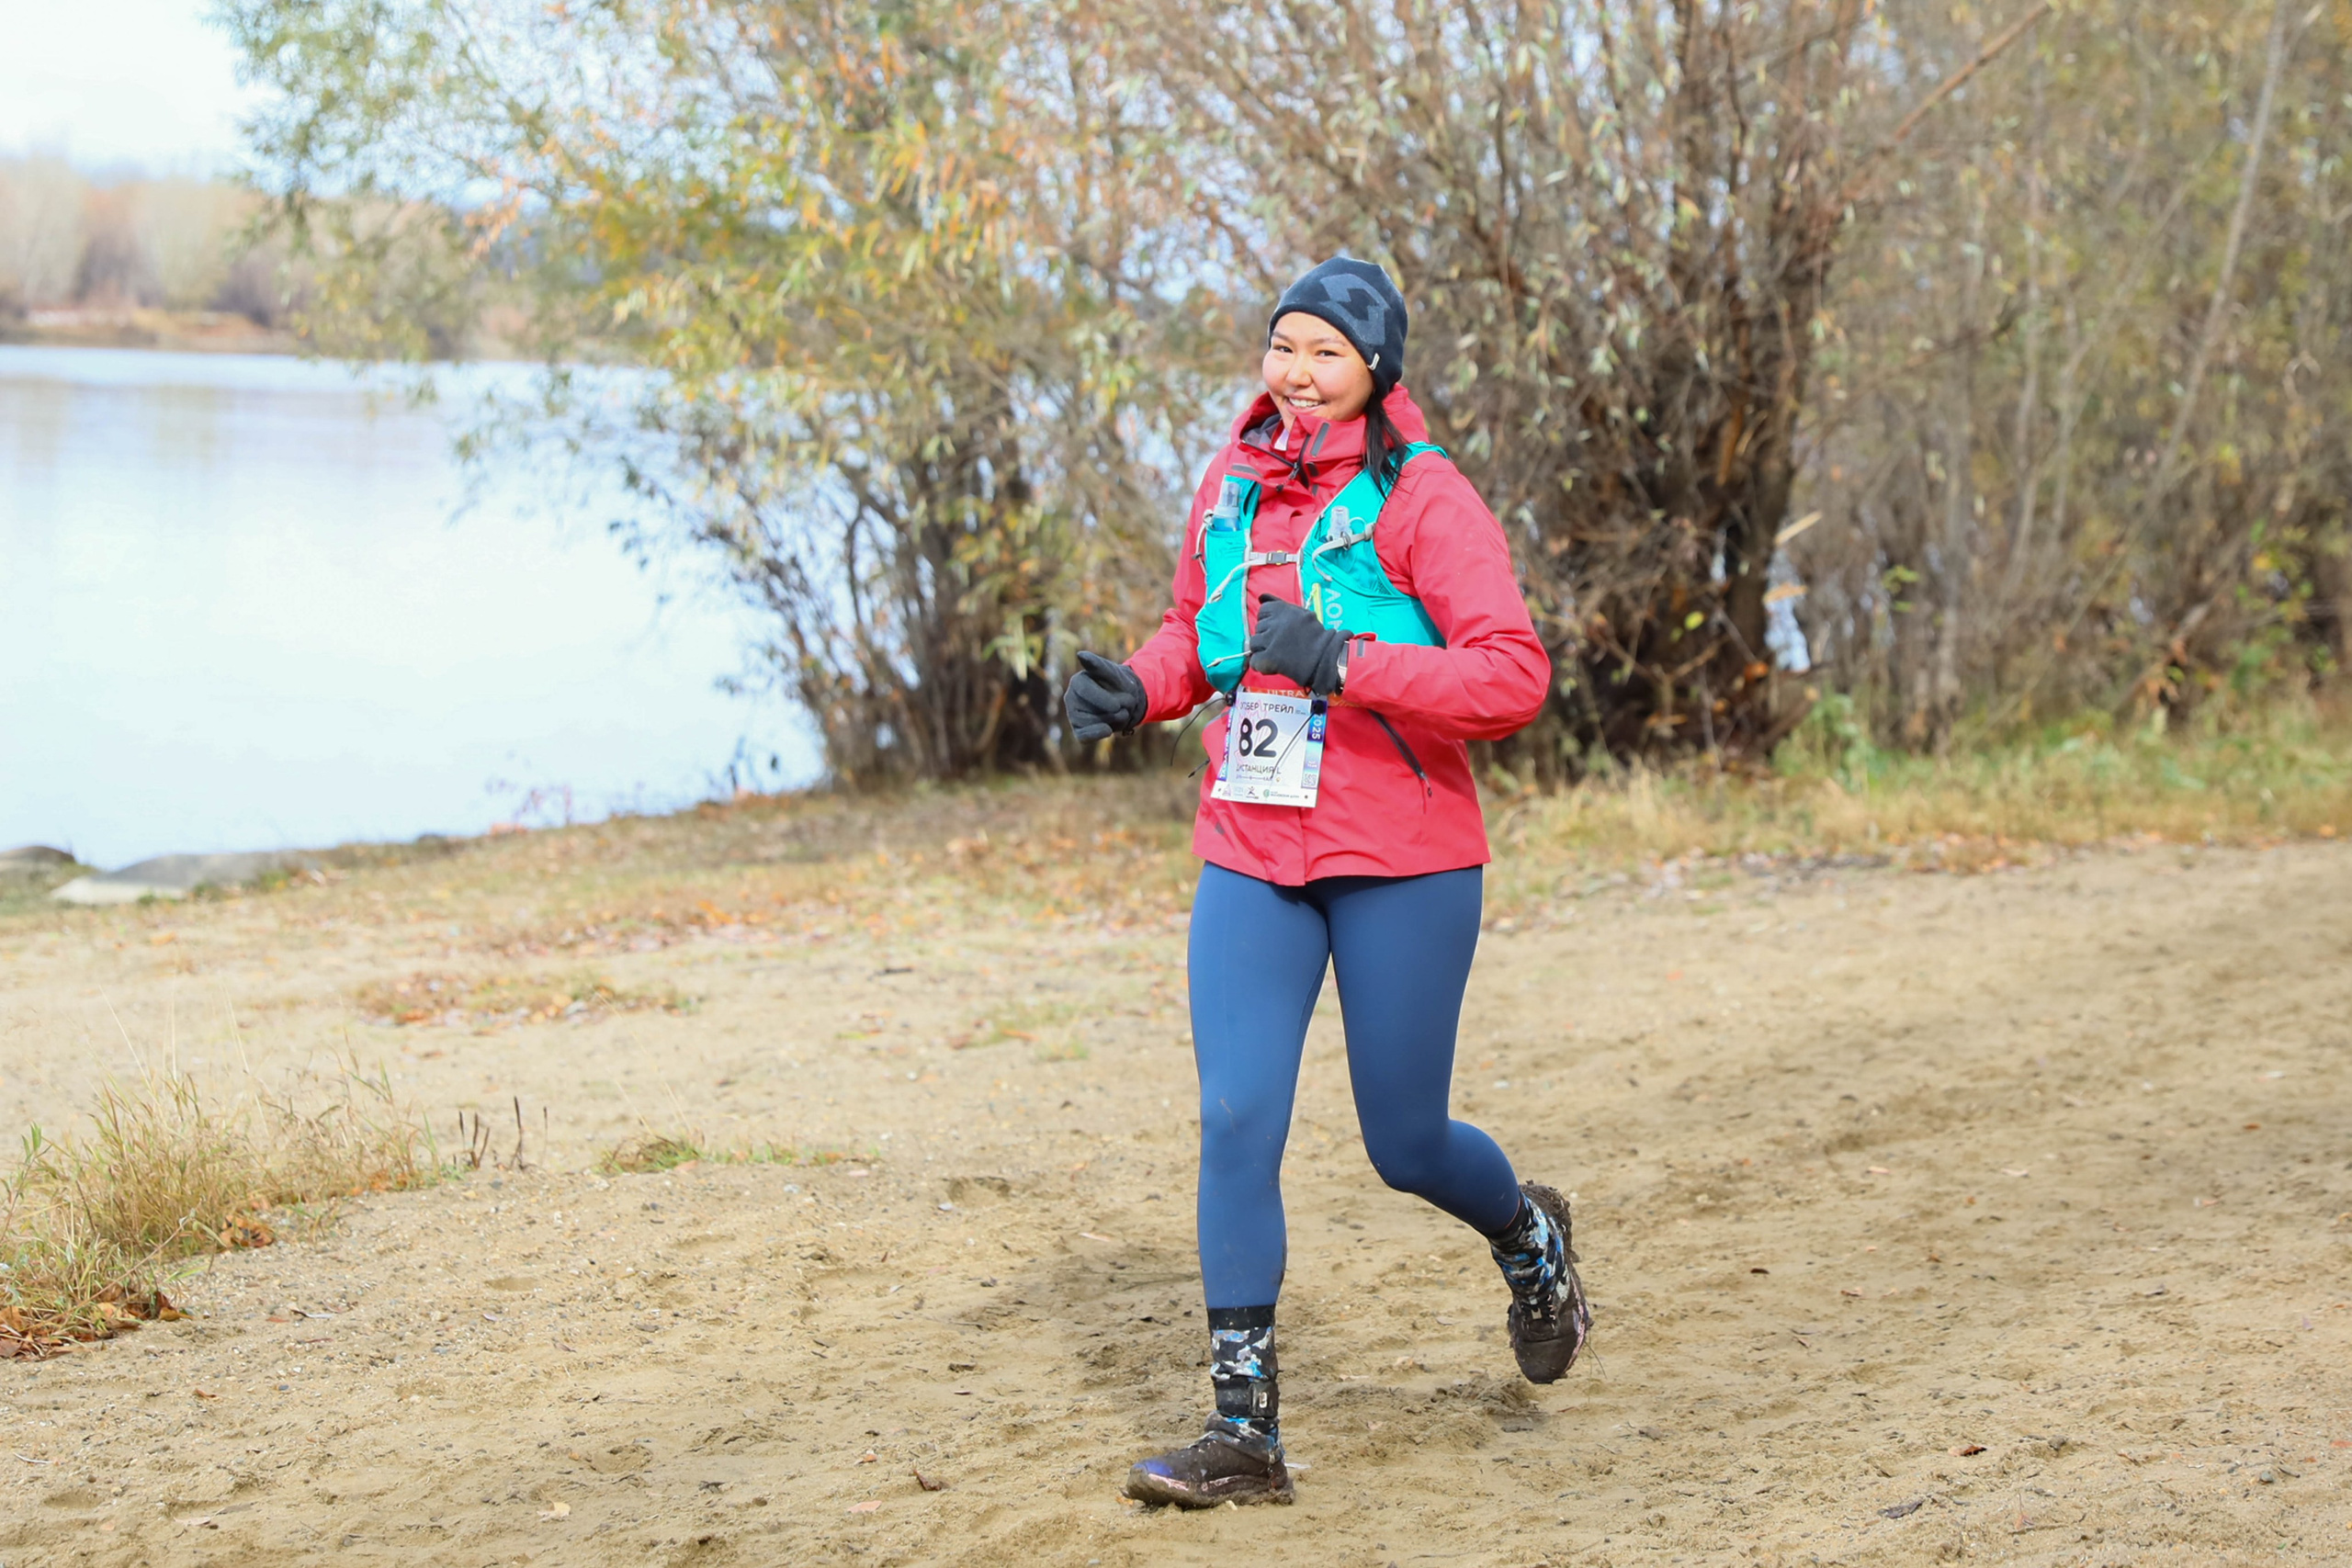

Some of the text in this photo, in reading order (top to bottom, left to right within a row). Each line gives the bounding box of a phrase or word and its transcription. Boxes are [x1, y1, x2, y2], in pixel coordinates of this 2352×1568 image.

[1262, 703, 1295, 714] ТРЕЙЛ
[1238, 717, 1279, 758] 82
[1311, 714, 1323, 740] 2025
